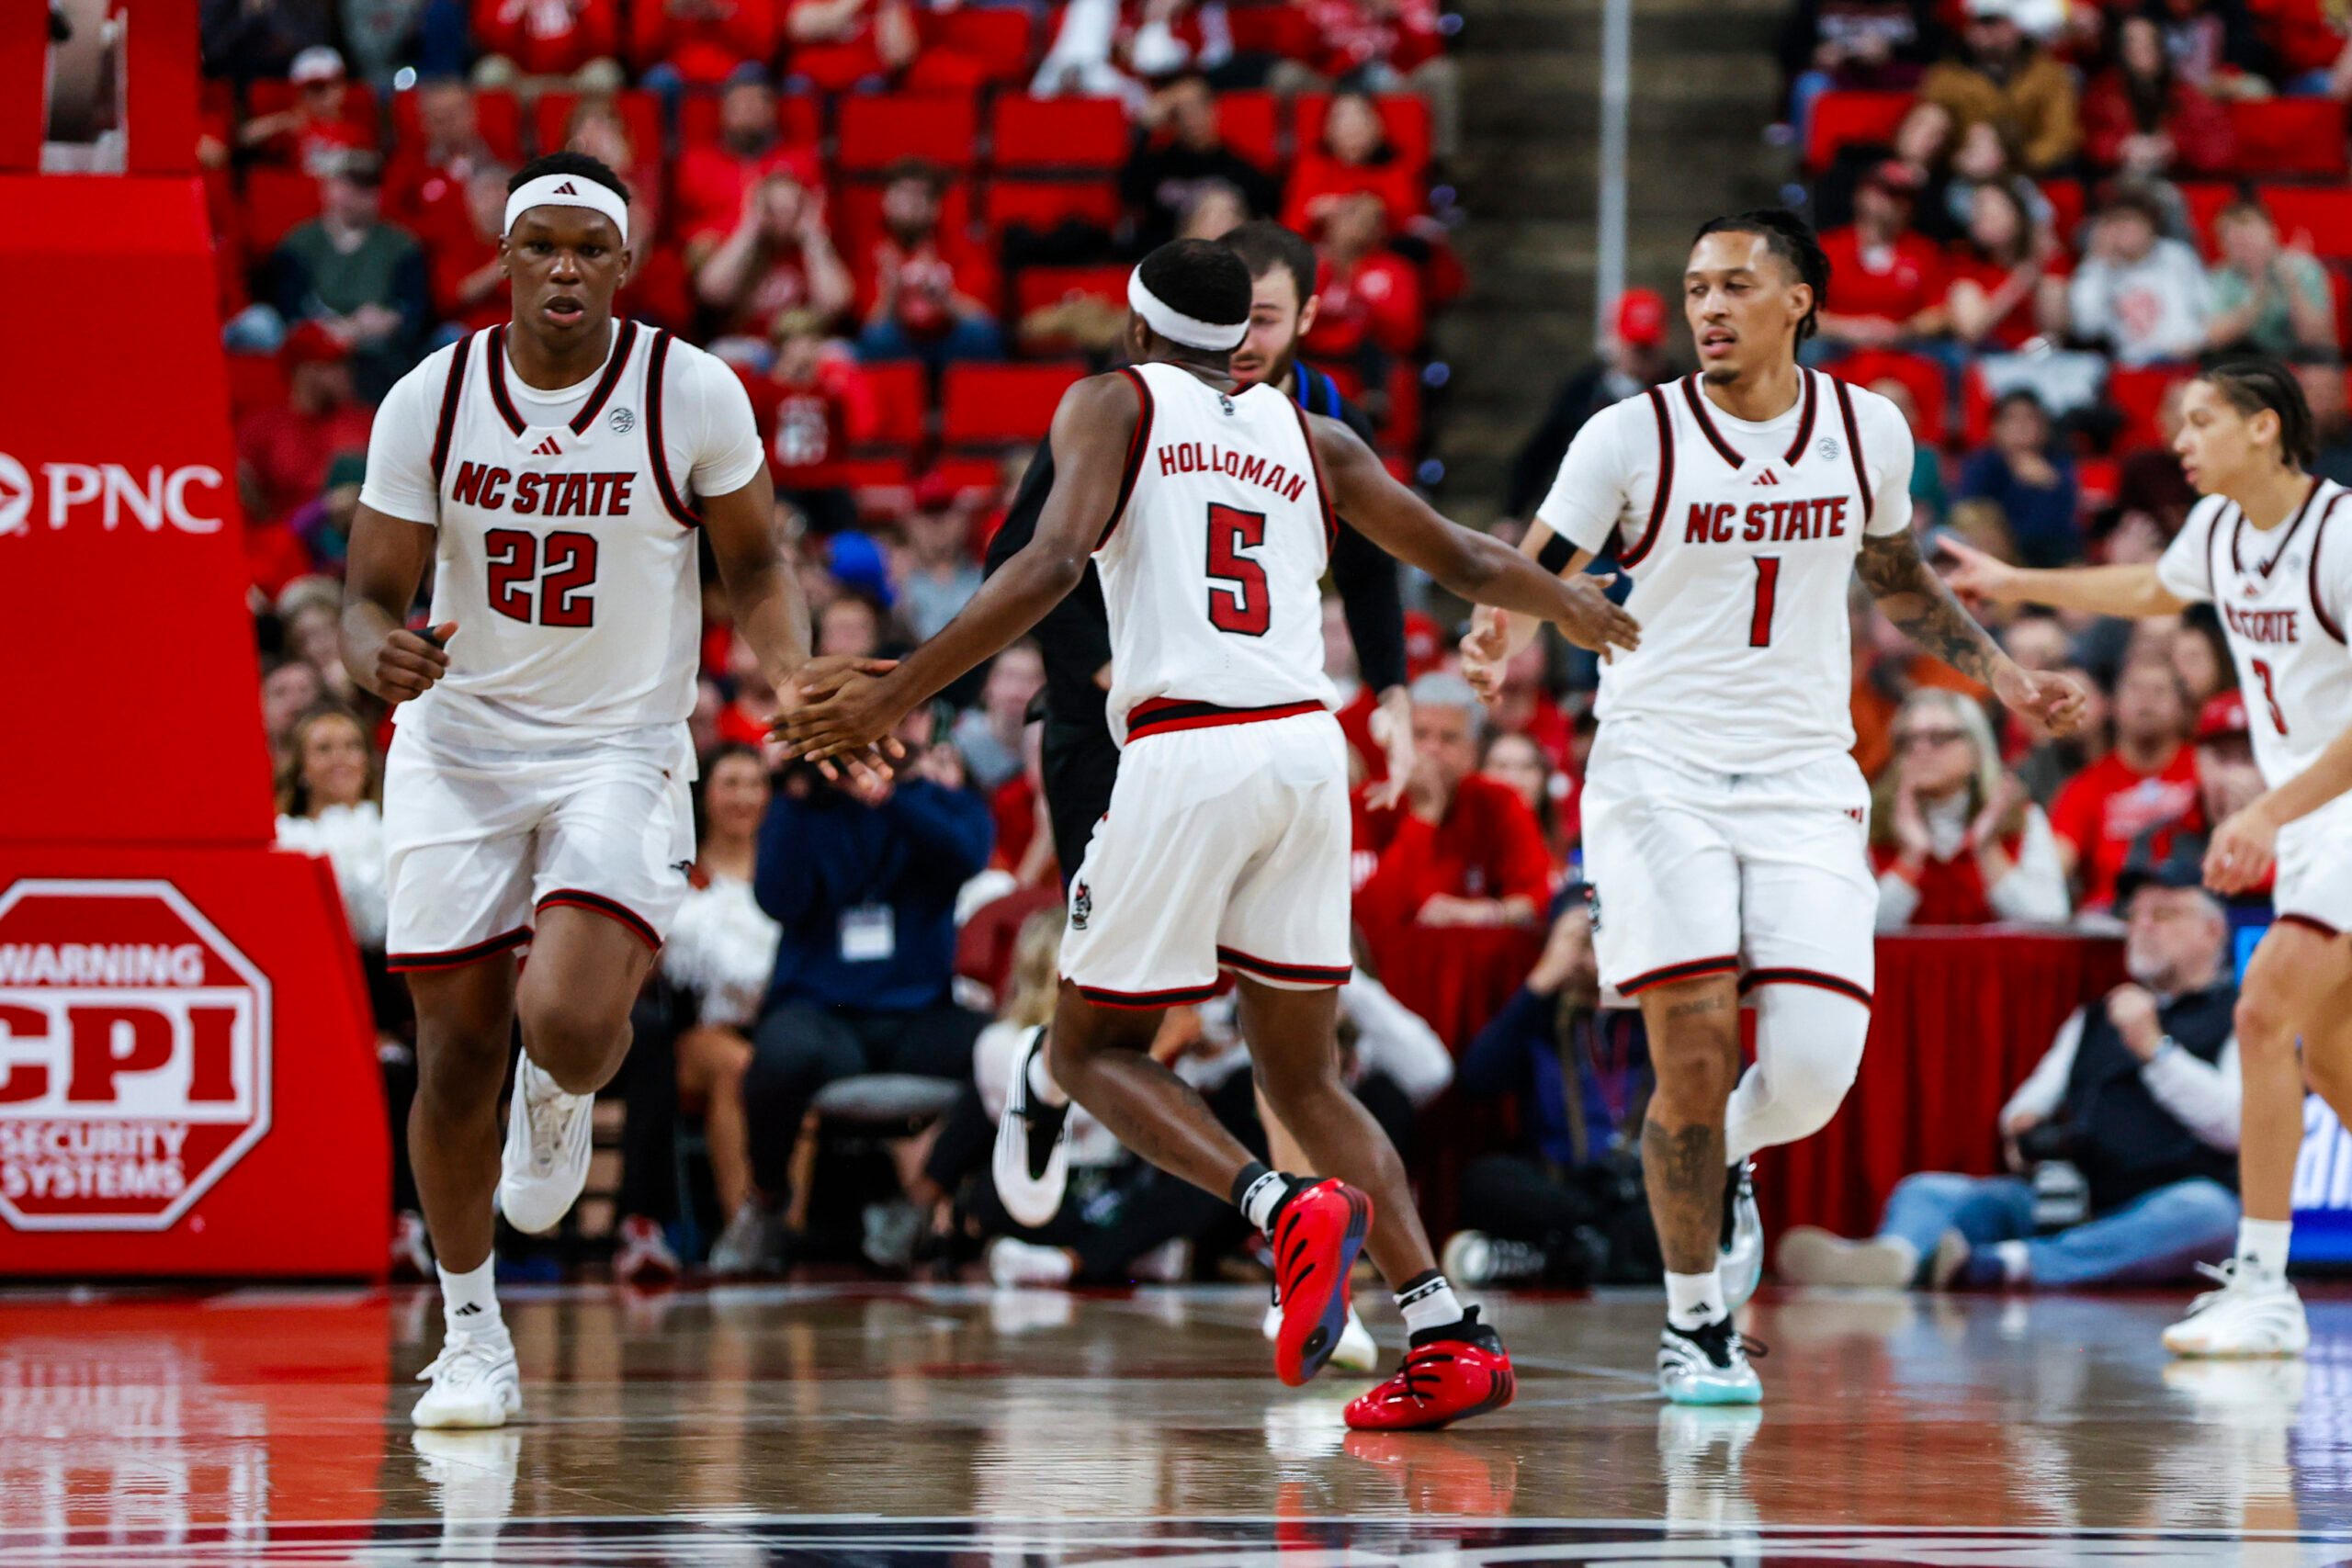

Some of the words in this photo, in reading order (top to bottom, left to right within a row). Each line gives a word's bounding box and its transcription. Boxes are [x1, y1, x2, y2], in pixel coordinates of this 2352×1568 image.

[40, 462, 224, 535] PNC
[452, 460, 512, 510] NC
[512, 471, 638, 516] STATE
[1158, 442, 1307, 502] HOLLOMAN
[1684, 502, 1736, 544] NC
[1742, 494, 1850, 542] STATE
[484, 527, 599, 627] 22
[1205, 501, 1271, 637] 5
[1748, 555, 1781, 648] 1
[0, 943, 205, 986] WARNING
[0, 1122, 189, 1156] SECURITY
[1, 1159, 186, 1198] SYSTEMS
